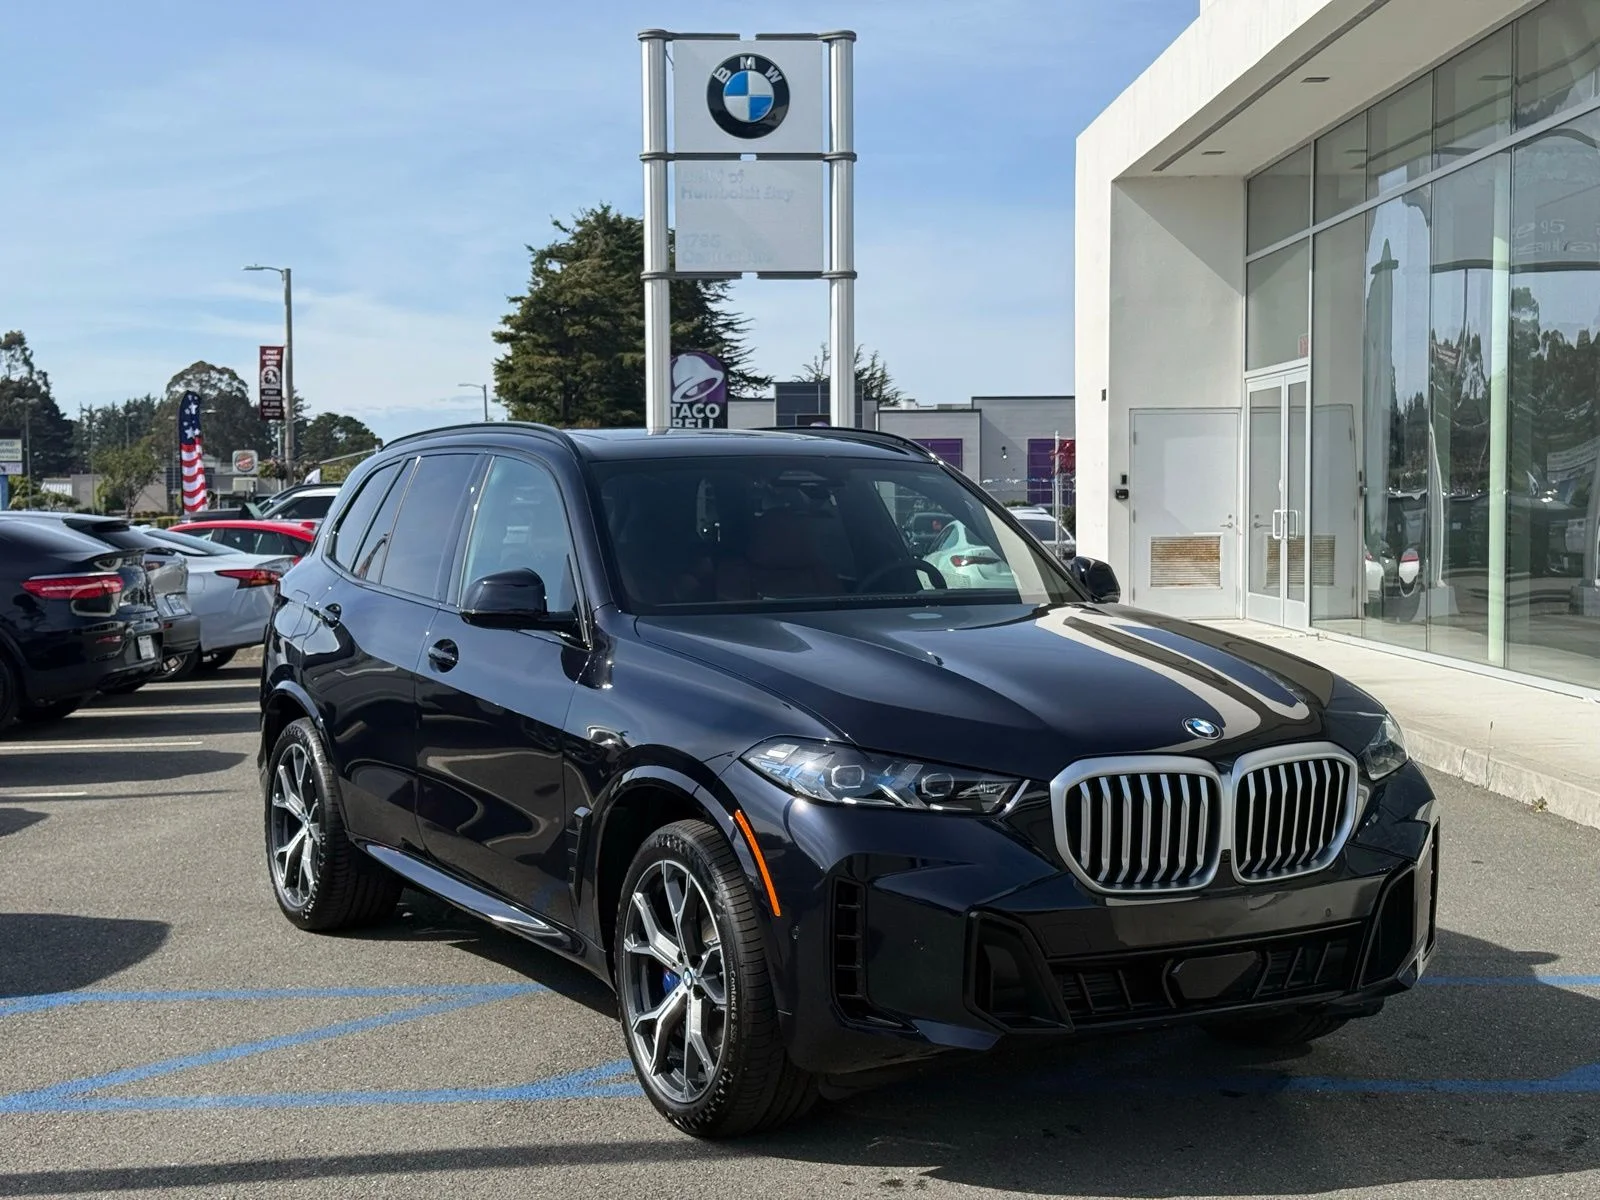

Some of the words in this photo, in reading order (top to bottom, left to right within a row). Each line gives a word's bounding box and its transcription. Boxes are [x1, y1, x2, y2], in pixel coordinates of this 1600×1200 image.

[712, 56, 783, 84] BMW
[728, 168, 745, 184] of
[670, 403, 720, 418] TACO
